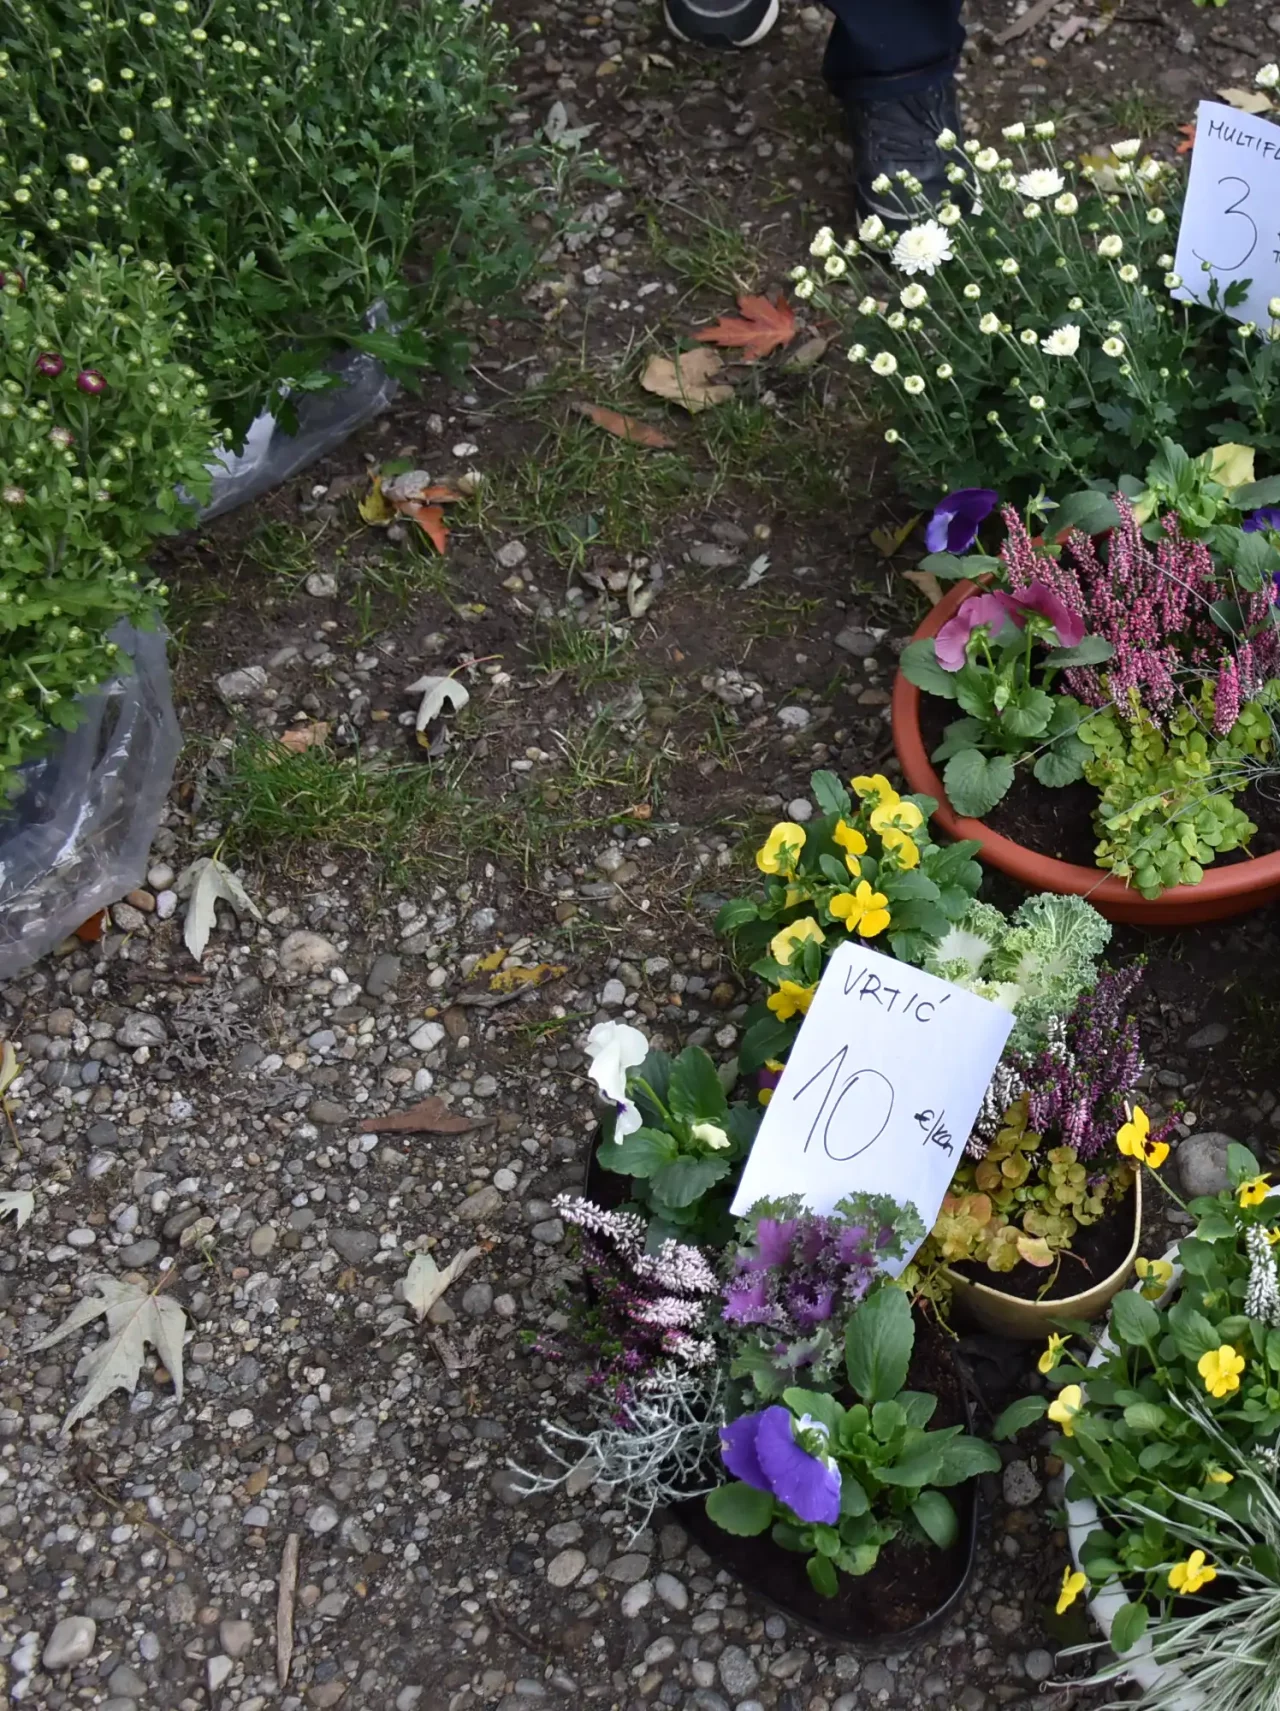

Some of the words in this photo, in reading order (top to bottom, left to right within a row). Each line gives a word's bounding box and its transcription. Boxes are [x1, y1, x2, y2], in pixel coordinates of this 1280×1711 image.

[1192, 176, 1258, 271] 3
[843, 965, 951, 1022] VRTIĆ
[793, 1044, 895, 1161] 10
